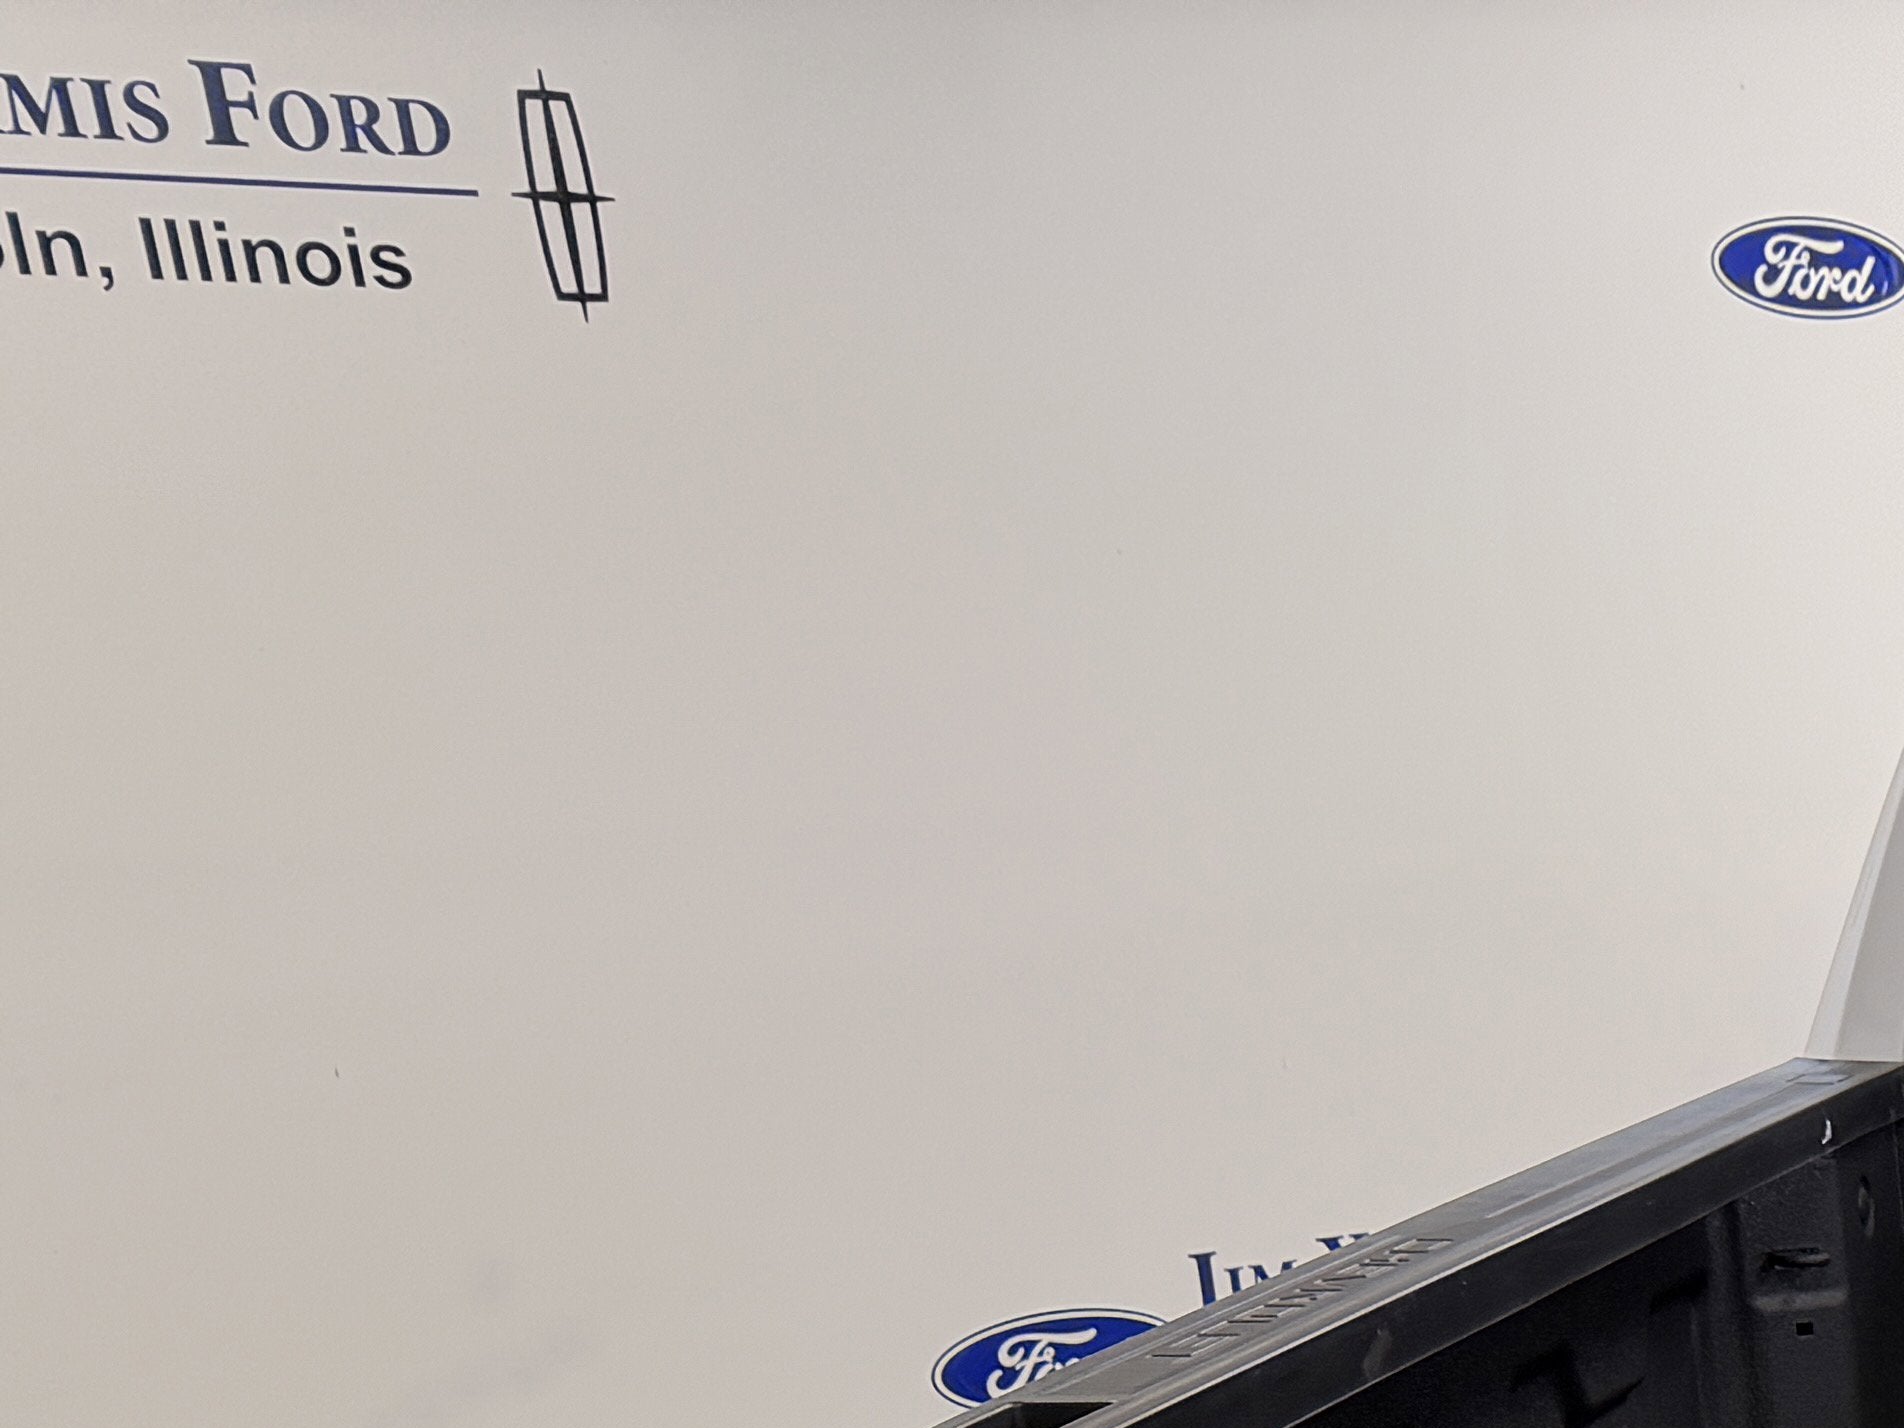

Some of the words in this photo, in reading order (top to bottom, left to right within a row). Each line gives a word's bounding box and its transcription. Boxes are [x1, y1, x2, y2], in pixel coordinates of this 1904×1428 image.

[0, 73, 169, 143] MIS
[187, 59, 450, 156] FORD
[0, 211, 114, 291] ln,
[138, 217, 412, 289] Illinois
[1754, 233, 1876, 303] Ford
